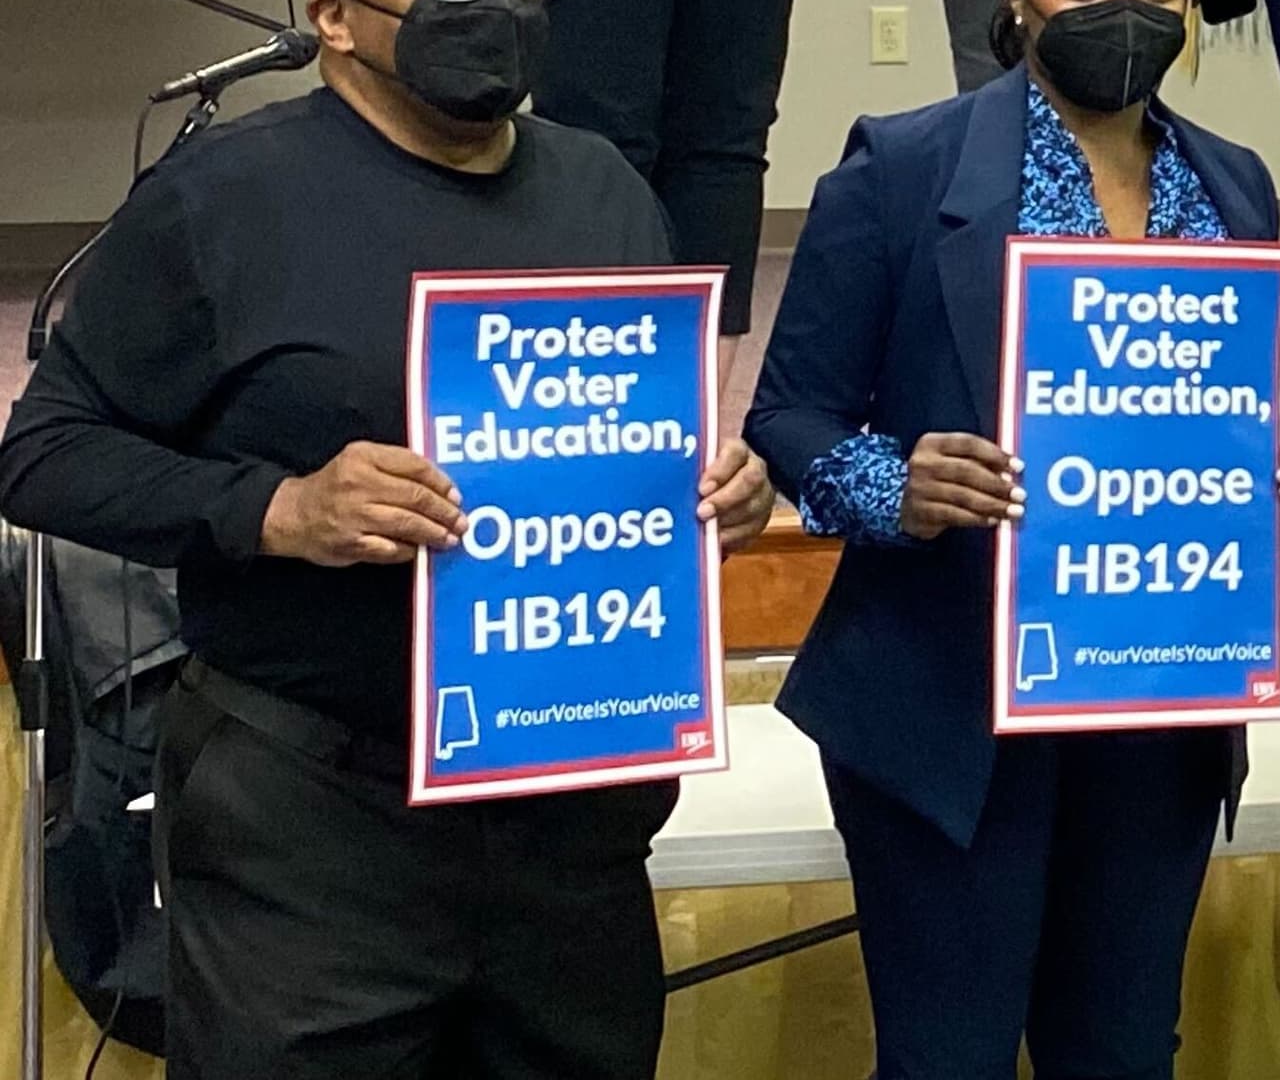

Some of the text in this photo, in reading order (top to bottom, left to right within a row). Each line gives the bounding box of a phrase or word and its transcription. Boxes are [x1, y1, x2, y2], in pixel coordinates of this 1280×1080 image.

[1073, 277, 1239, 324] Protect
[477, 313, 657, 362] Protect
[1088, 325, 1222, 369] Voter
[493, 362, 638, 410] Voter
[1025, 370, 1272, 422] Education,
[435, 407, 698, 464] Education,
[1047, 456, 1253, 516] Oppose
[462, 505, 673, 568] Oppose
[1056, 542, 1242, 594] HB194
[473, 585, 666, 655] HB194
[1074, 642, 1272, 666] #YourVoteIsYourVoice
[495, 691, 700, 728] #YourVoteIsYourVoice
